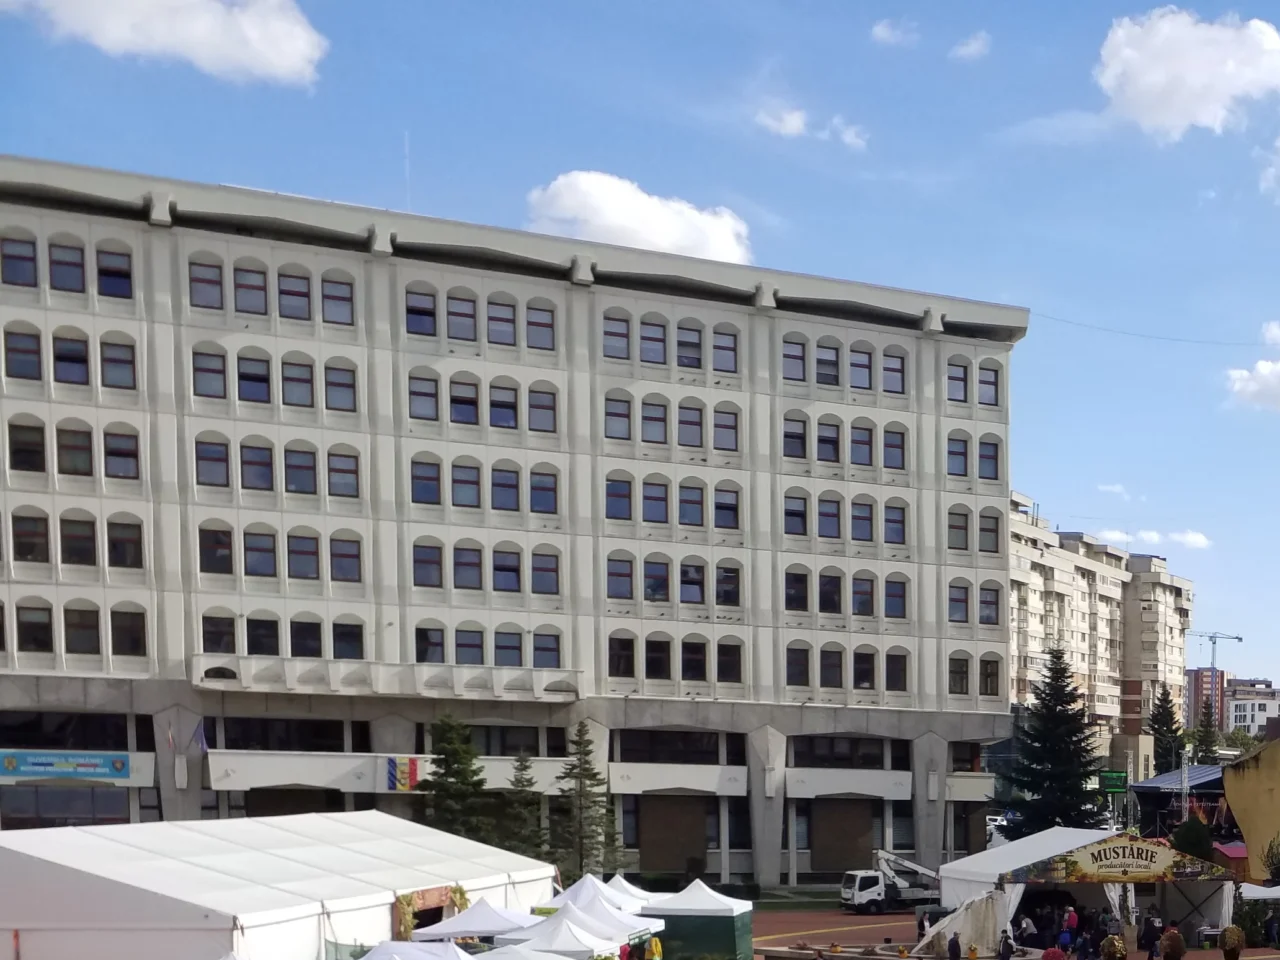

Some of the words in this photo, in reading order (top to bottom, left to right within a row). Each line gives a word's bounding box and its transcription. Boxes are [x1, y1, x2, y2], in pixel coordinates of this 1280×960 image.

[1090, 844, 1158, 865] MUSTĂRIE
[1097, 860, 1134, 872] producători
[1135, 861, 1152, 870] locali
